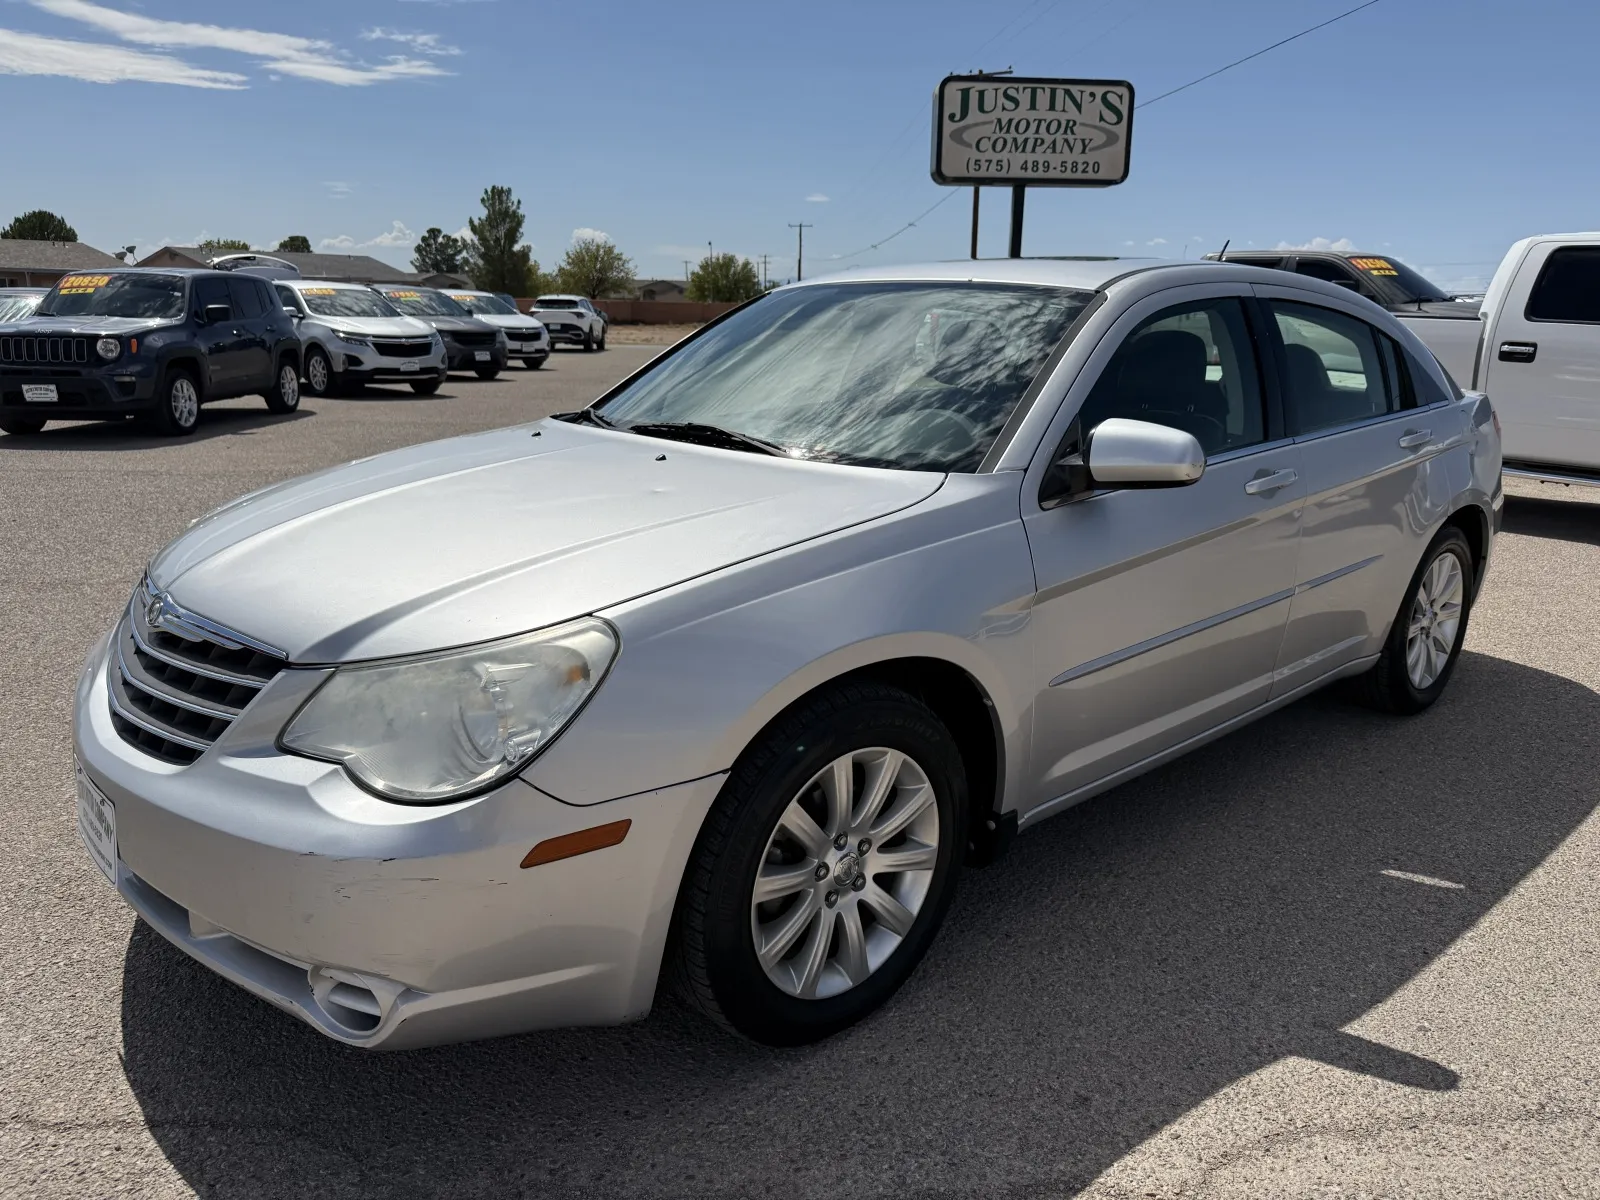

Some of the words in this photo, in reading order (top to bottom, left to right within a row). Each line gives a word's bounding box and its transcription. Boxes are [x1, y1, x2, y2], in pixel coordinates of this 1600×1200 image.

[948, 86, 1124, 126] JUSTIN'S
[992, 117, 1079, 136] MOTOR
[975, 136, 1093, 155] COMPANY
[966, 158, 1011, 174] (575)
[1020, 160, 1100, 174] 489-5820
